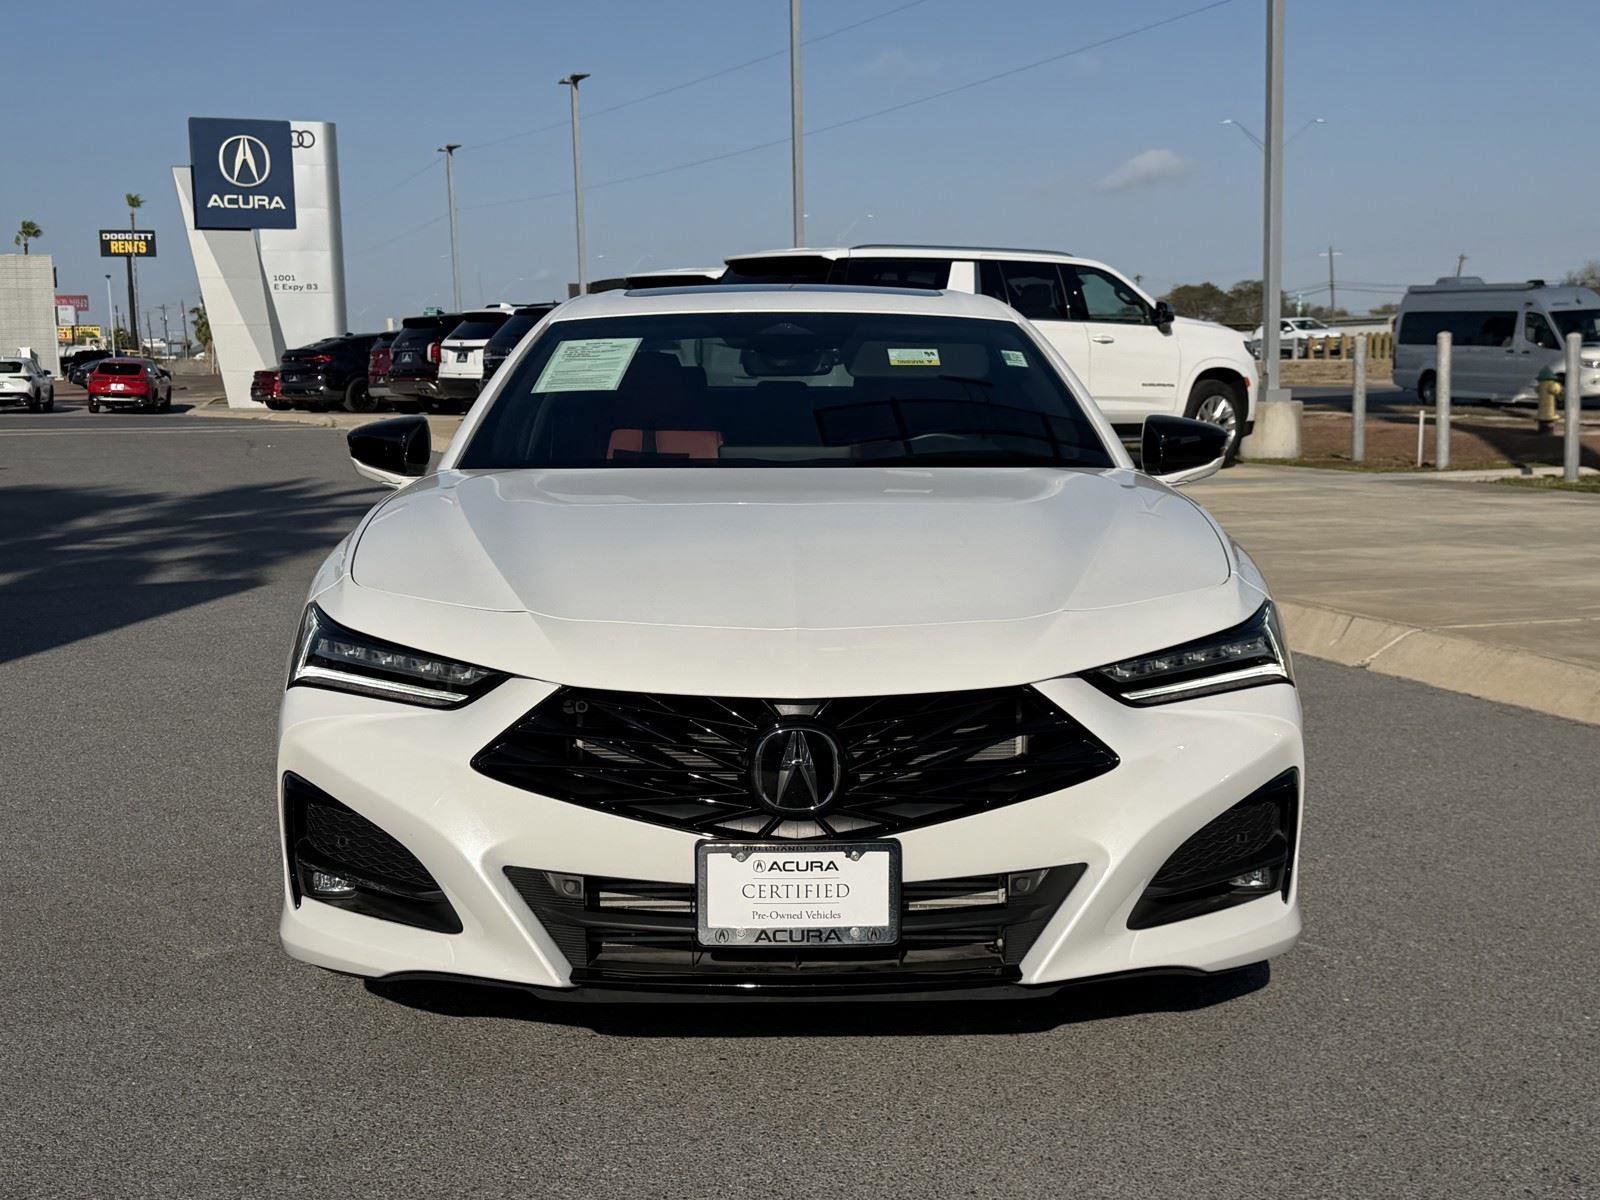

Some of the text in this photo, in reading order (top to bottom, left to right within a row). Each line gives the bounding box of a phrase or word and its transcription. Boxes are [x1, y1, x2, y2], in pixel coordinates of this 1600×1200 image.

[207, 193, 287, 210] ACURA
[102, 232, 154, 241] DOGGETT
[110, 240, 147, 254] RENTS
[273, 274, 296, 282] 1001
[273, 283, 280, 291] E
[282, 283, 304, 292] Expy
[767, 860, 840, 872] ACURA
[741, 883, 850, 899] CERTIFIED
[752, 910, 842, 920] Pre-Owned Vehicles
[754, 929, 842, 943] ACURA
